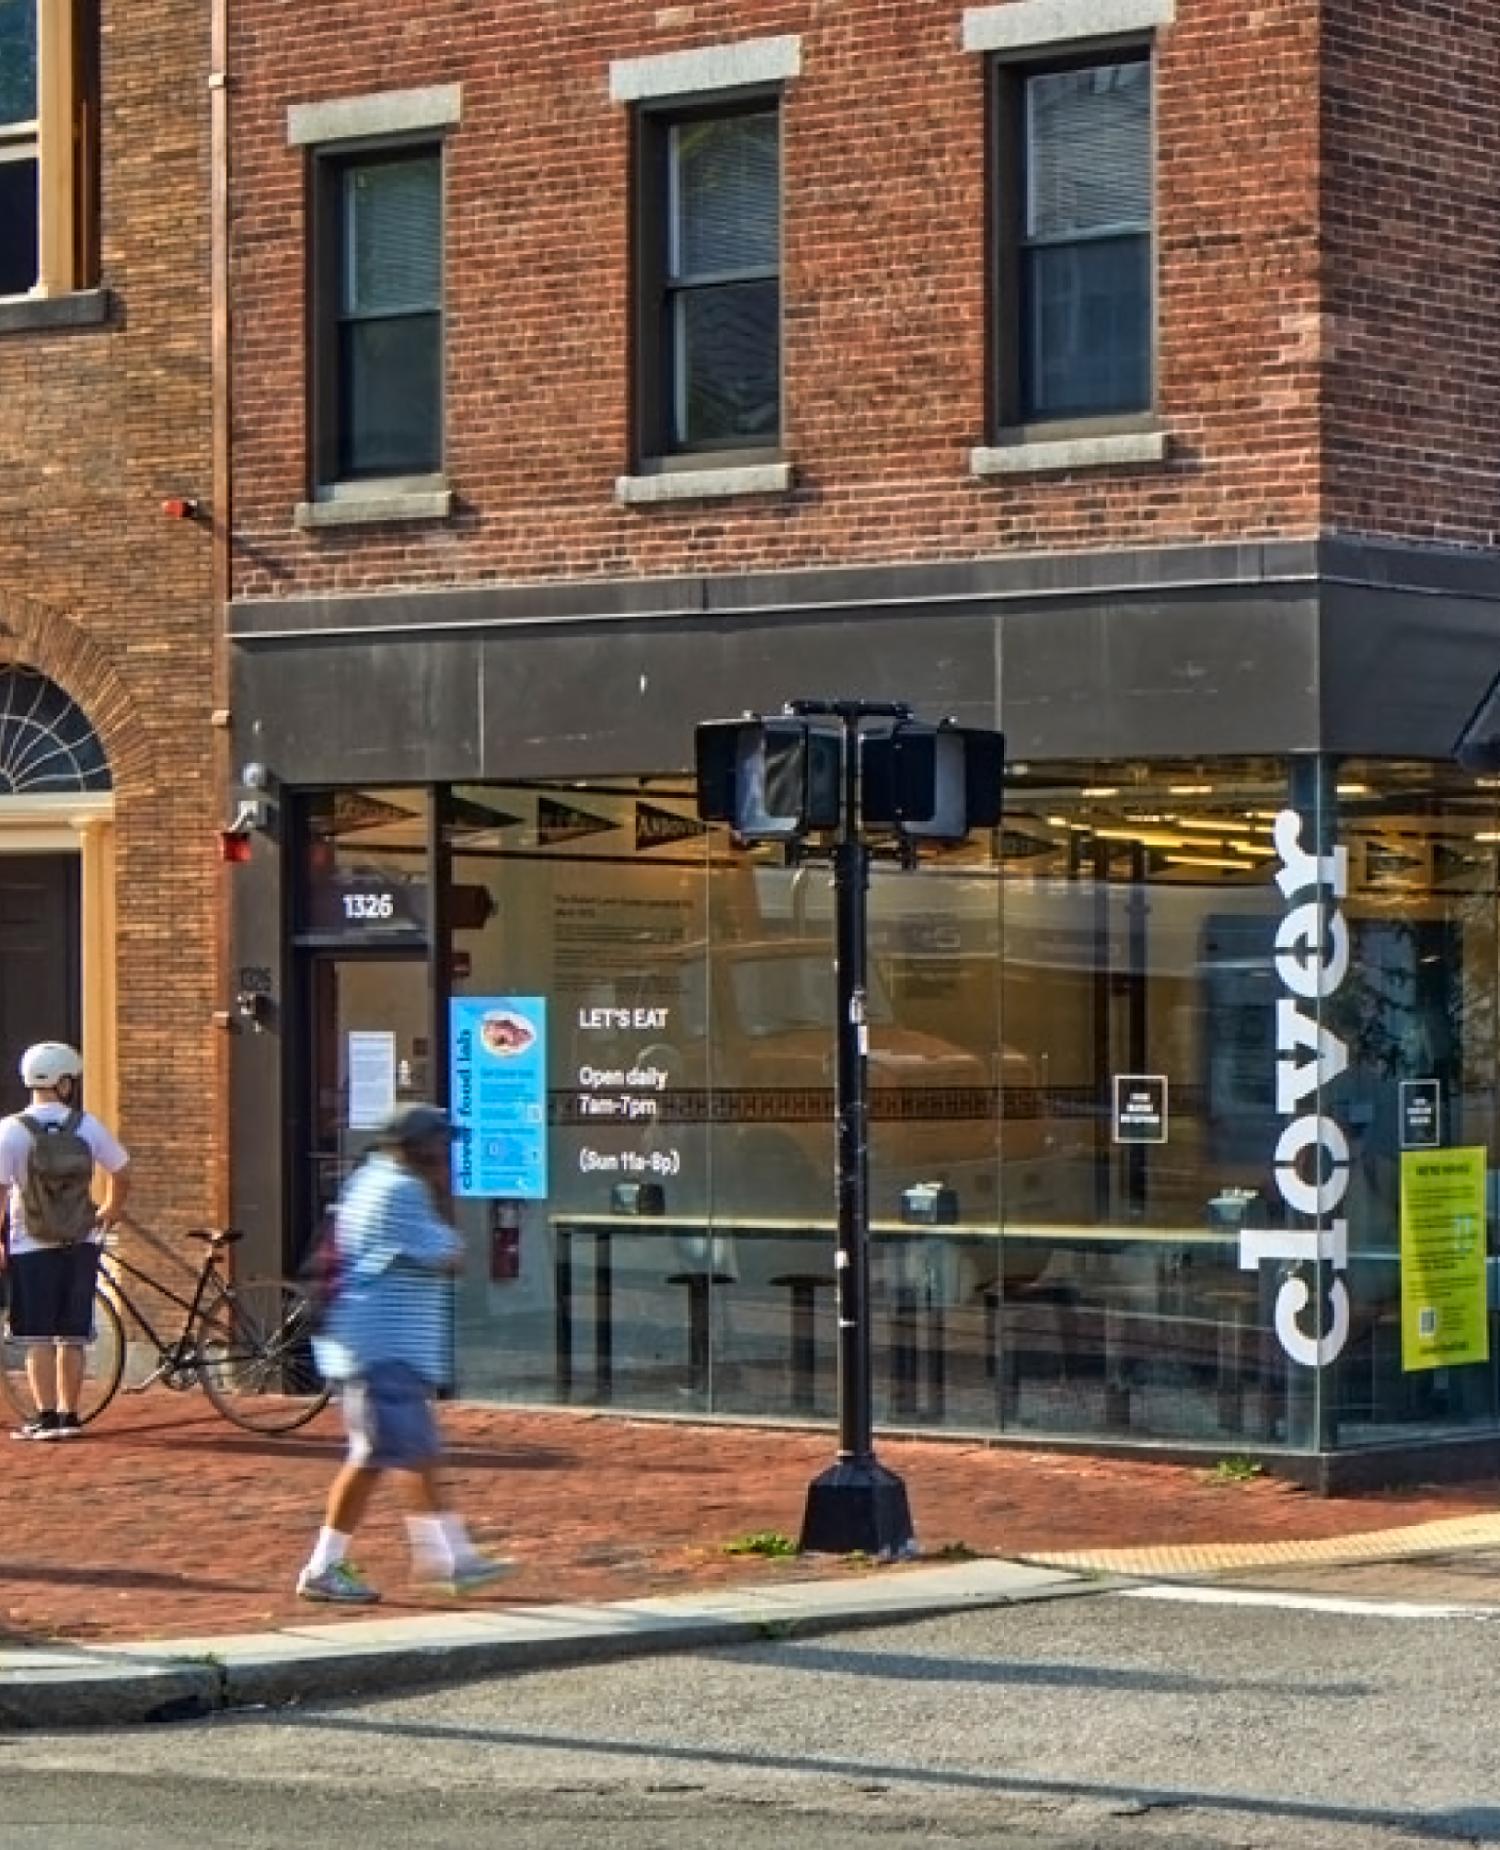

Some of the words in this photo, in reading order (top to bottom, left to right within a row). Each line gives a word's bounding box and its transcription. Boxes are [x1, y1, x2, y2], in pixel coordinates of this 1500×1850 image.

[342, 893, 394, 919] 1326
[579, 1007, 630, 1030] LET'S
[634, 1007, 669, 1030] EAT
[579, 1066, 625, 1089] Open
[626, 1067, 669, 1091] daily
[1239, 808, 1350, 1366] clover
[579, 1094, 656, 1119] 7am-7pm
[579, 1147, 619, 1174] (Sun
